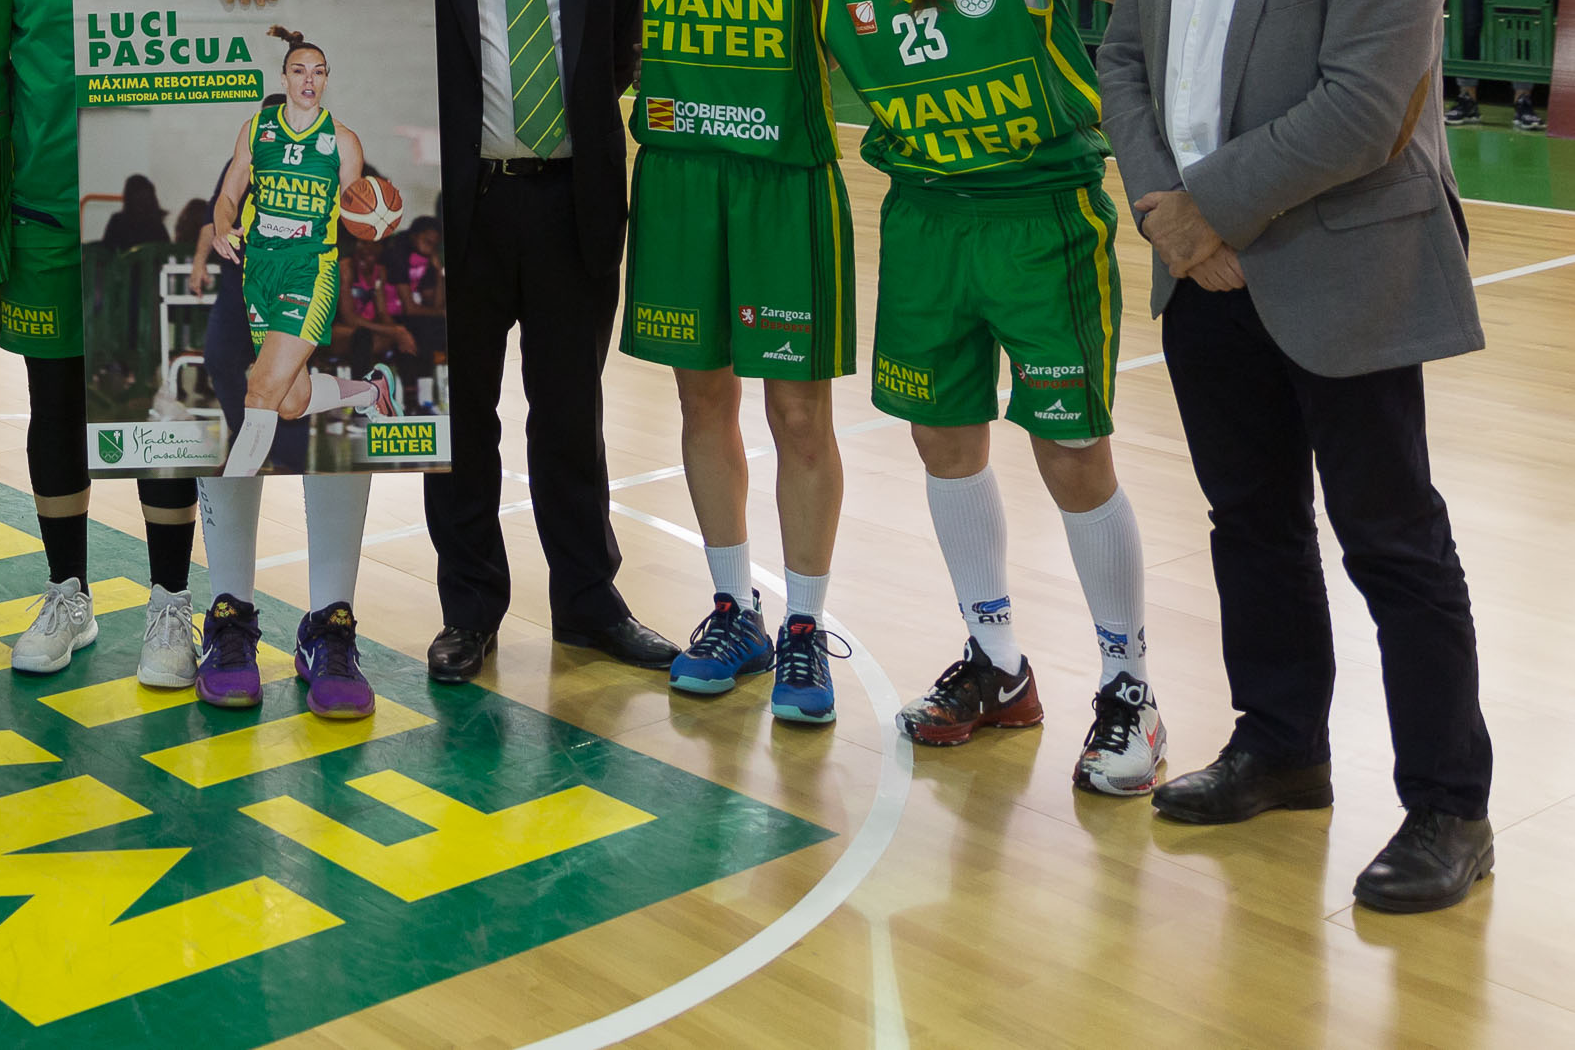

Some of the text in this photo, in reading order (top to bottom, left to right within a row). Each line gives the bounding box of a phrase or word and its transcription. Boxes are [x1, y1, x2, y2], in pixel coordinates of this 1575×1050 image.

[88, 11, 177, 39] LUCI
[642, 19, 785, 58] FILTER
[892, 7, 948, 66] 23
[89, 37, 252, 67] PASCUA
[89, 74, 257, 90] MÁXIMA REBOTEADORA
[89, 89, 257, 103] EN LA HISTORIA DE LA LIGA FEMENINA
[869, 74, 1033, 131] MANN
[676, 101, 766, 124] GOBIERNO
[676, 119, 779, 141] DE ARAGON
[282, 143, 305, 165] 13
[259, 176, 327, 197] MANN
[259, 188, 326, 214] FILTER
[1, 301, 54, 322] MANN
[637, 307, 695, 326] MANN
[761, 306, 811, 321] Zaragoza
[1, 315, 55, 335] FILTER
[637, 322, 695, 340] FILTER
[762, 351, 806, 362] MERCURY
[879, 357, 929, 386] MANN
[1025, 363, 1084, 378] Zaragoza
[877, 371, 930, 400] FILTER
[1034, 410, 1081, 421] MERCURY
[133, 425, 203, 454] Stadium
[371, 425, 432, 438] MANN
[144, 445, 218, 463] Casablanca
[371, 439, 433, 453] FILTER
